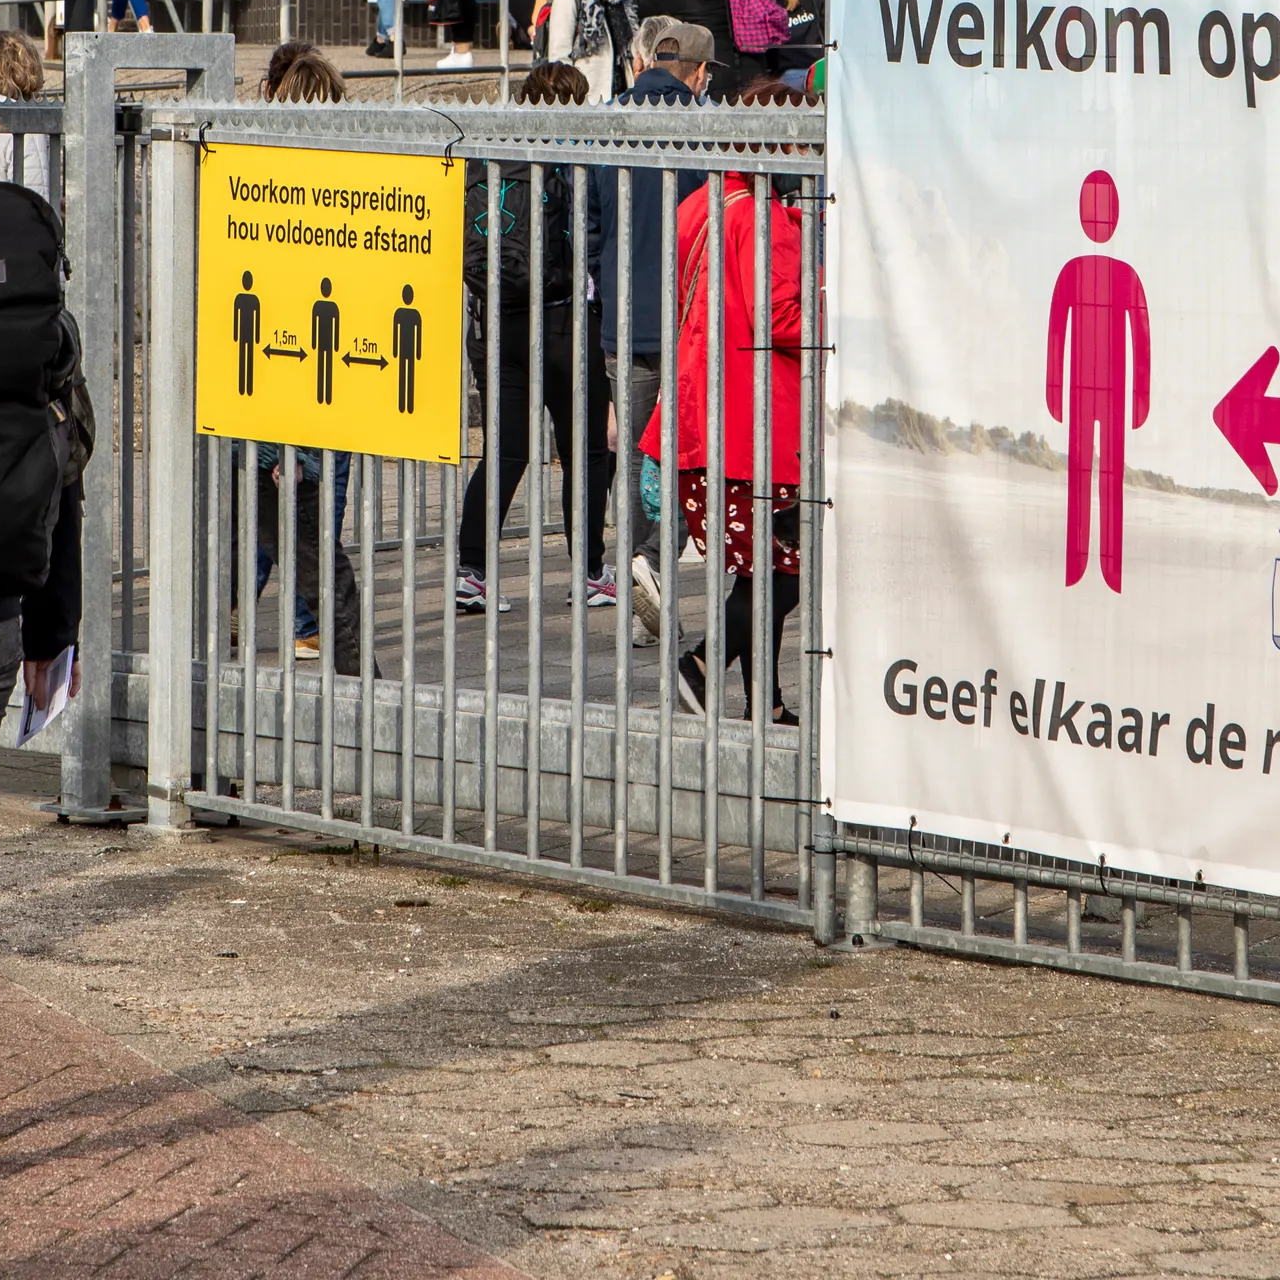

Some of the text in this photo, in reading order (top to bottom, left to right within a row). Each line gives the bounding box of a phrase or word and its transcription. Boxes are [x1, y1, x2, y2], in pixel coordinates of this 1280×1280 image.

[228, 175, 431, 222] Voorkom verspreiding,
[227, 214, 432, 255] hou voldoende afstand
[273, 329, 297, 346] 1,5m
[353, 337, 378, 354] 1,5m
[883, 659, 998, 728] Geef
[1009, 677, 1171, 758] elkaar
[1185, 702, 1248, 770] de
